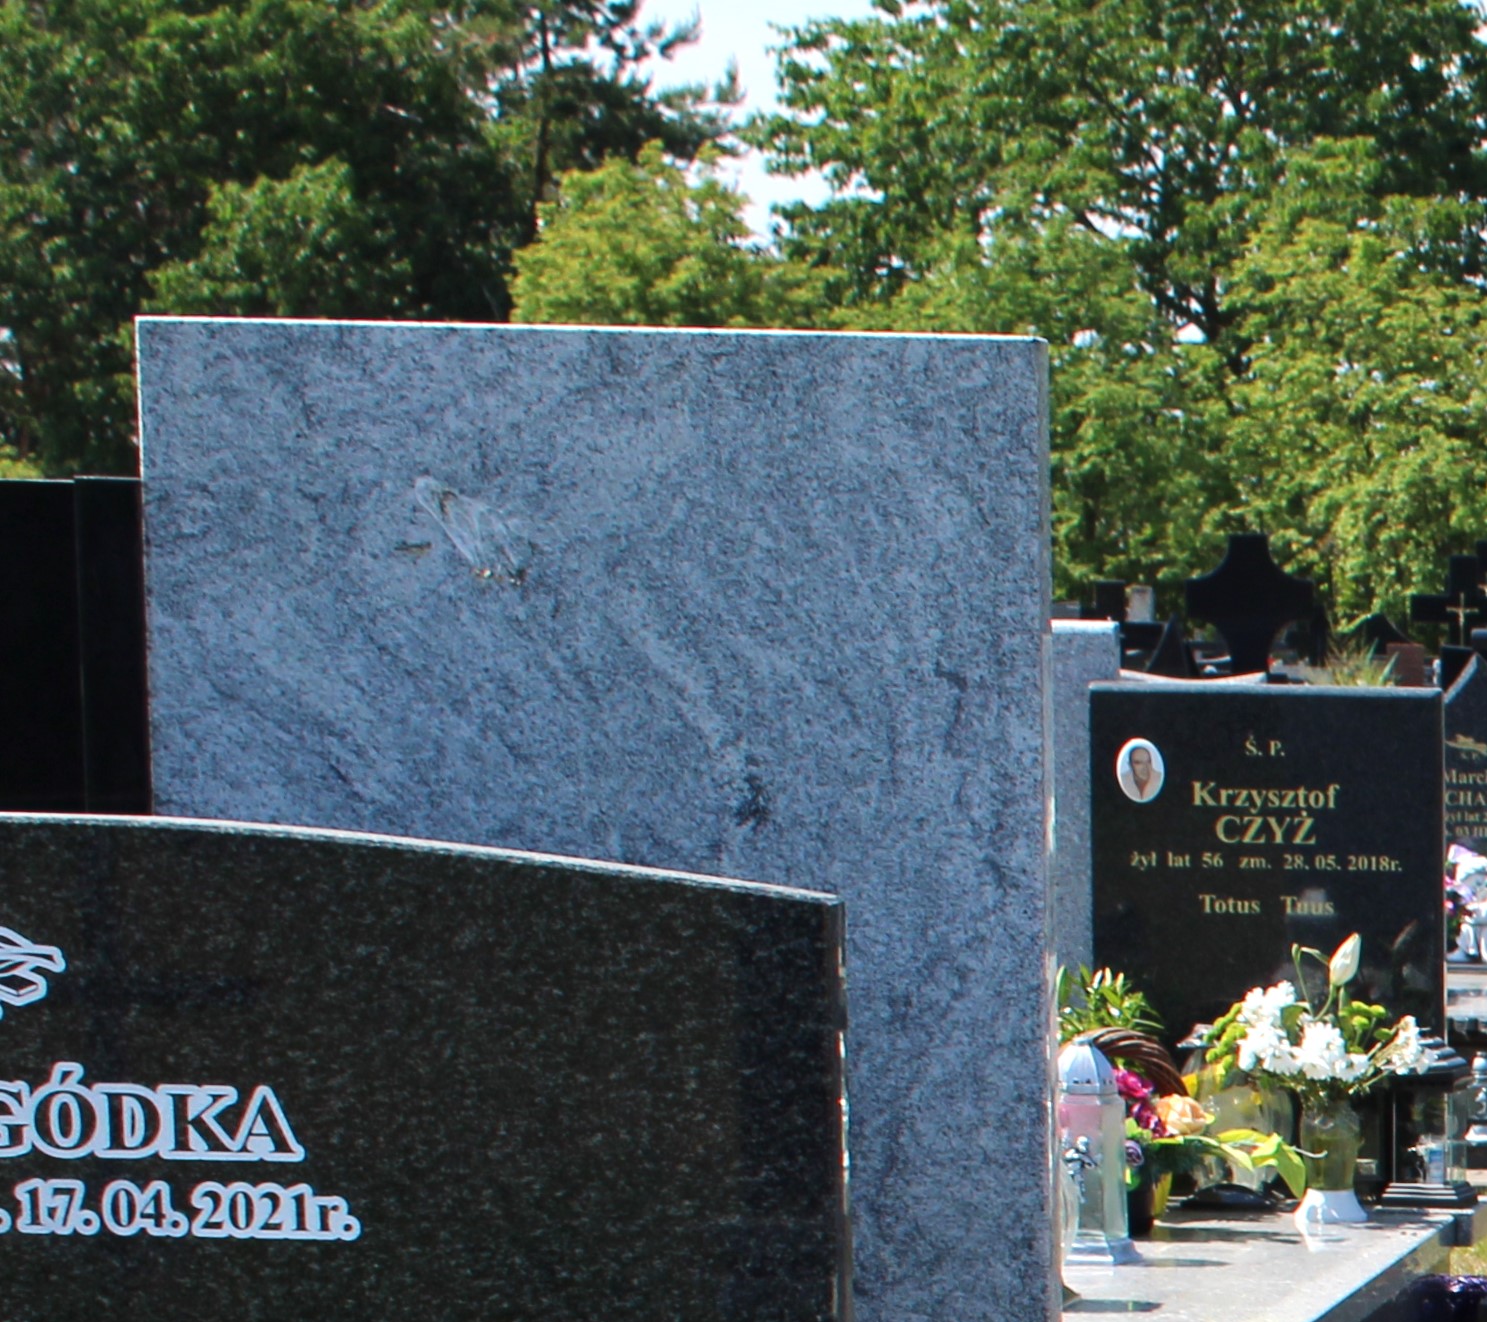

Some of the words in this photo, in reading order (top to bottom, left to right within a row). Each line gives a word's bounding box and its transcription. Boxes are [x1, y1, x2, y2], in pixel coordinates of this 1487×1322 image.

[1192, 780, 1340, 813] Krzysztof
[1215, 810, 1317, 845] CZYŻ
[1129, 850, 1158, 871] żył
[1166, 850, 1191, 869] lat
[1201, 852, 1224, 869] 56
[1238, 856, 1272, 870] zm.
[1199, 893, 1261, 915] Totus
[1280, 894, 1335, 916] Tuus
